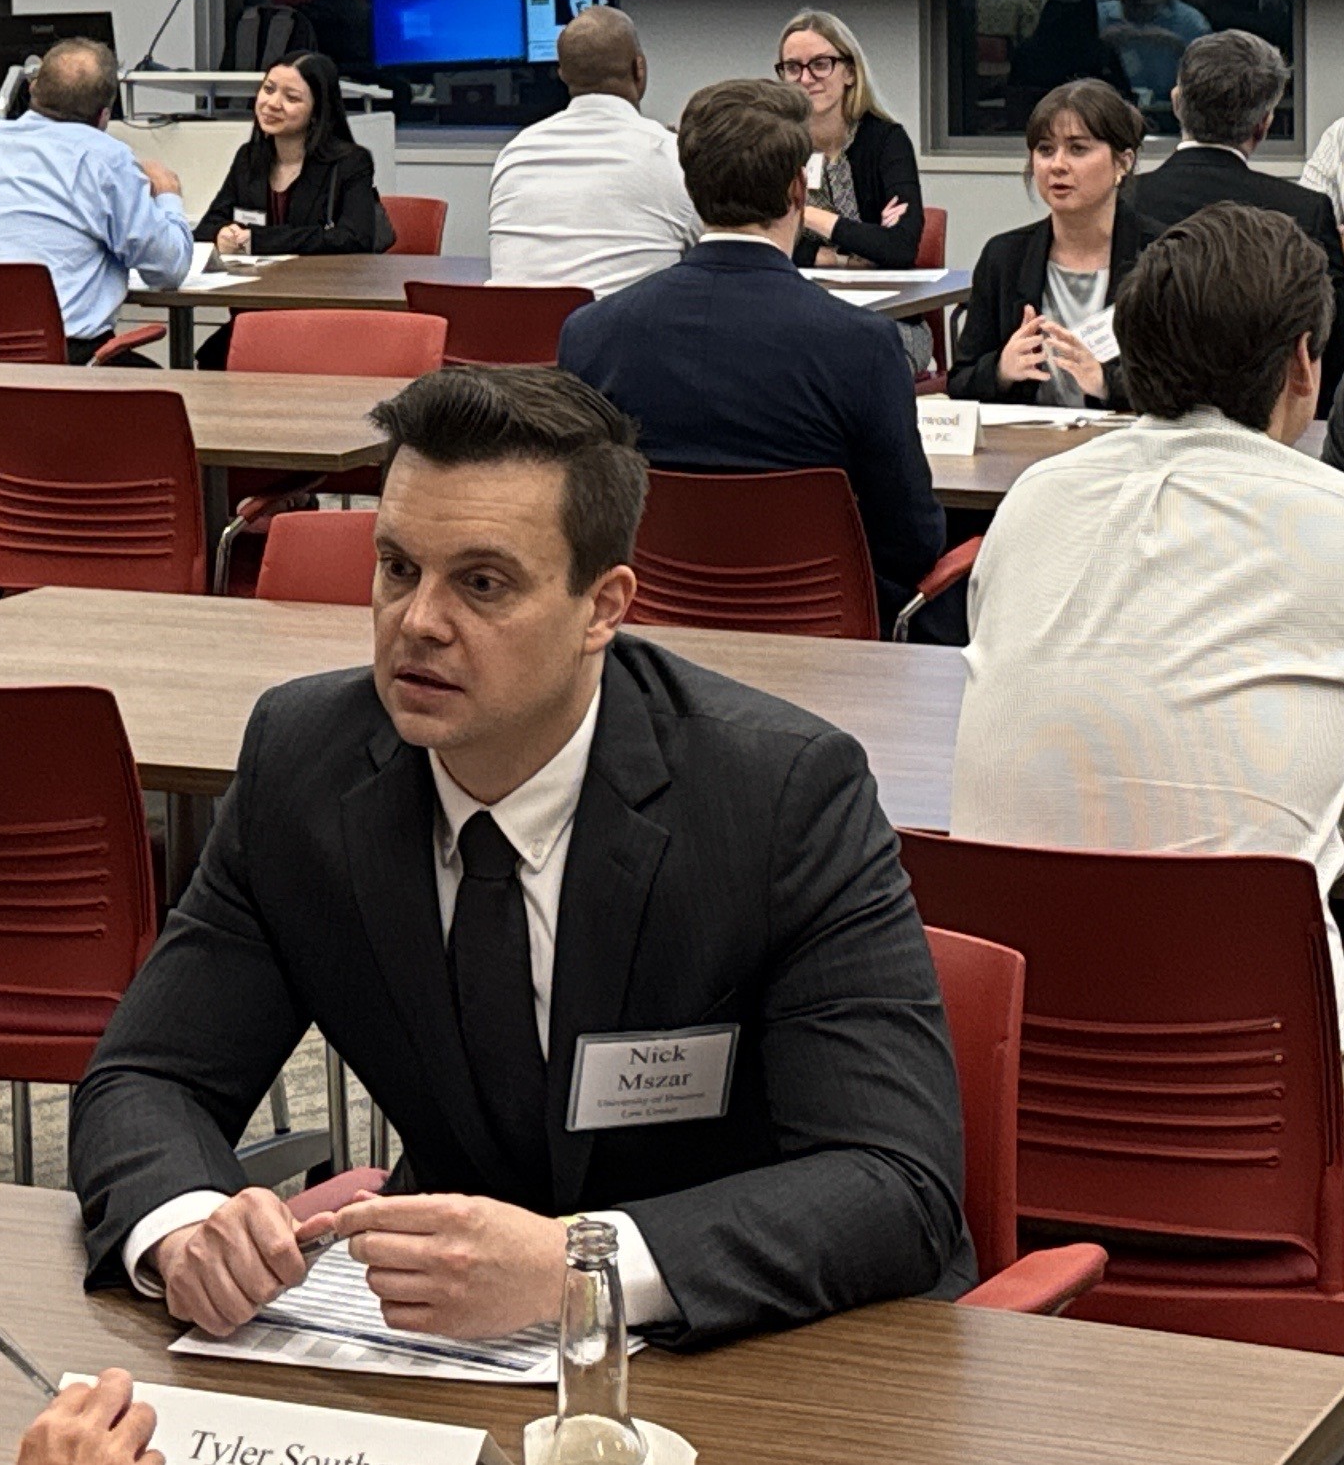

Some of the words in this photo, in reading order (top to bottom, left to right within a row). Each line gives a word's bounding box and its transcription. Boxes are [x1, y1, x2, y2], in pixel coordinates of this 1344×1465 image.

[629, 1045, 688, 1065] Nick
[618, 1072, 693, 1092] Mszar
[189, 1429, 274, 1465] Tyler
